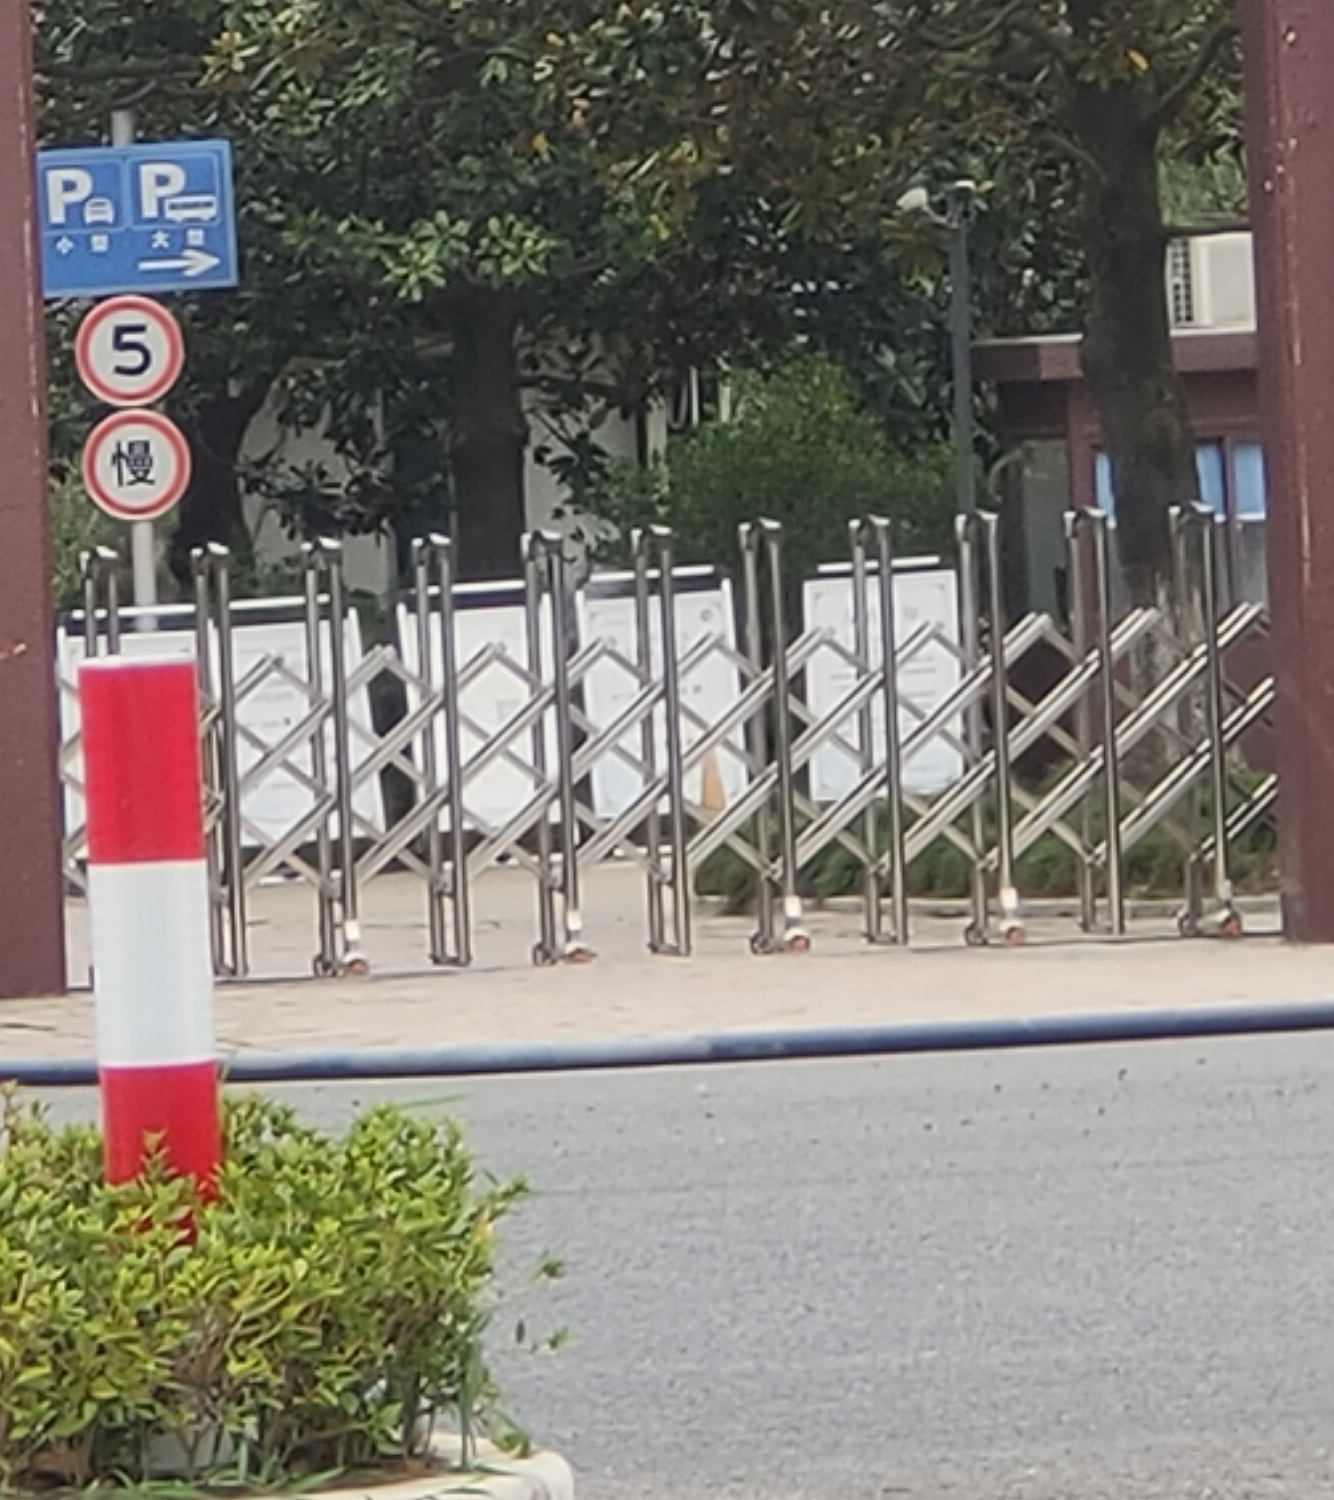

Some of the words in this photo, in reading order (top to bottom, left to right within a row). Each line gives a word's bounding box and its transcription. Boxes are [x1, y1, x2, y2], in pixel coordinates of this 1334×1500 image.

[46, 168, 92, 223] P
[139, 162, 185, 218] P
[112, 323, 151, 376] 5
[111, 439, 155, 488] 慢
